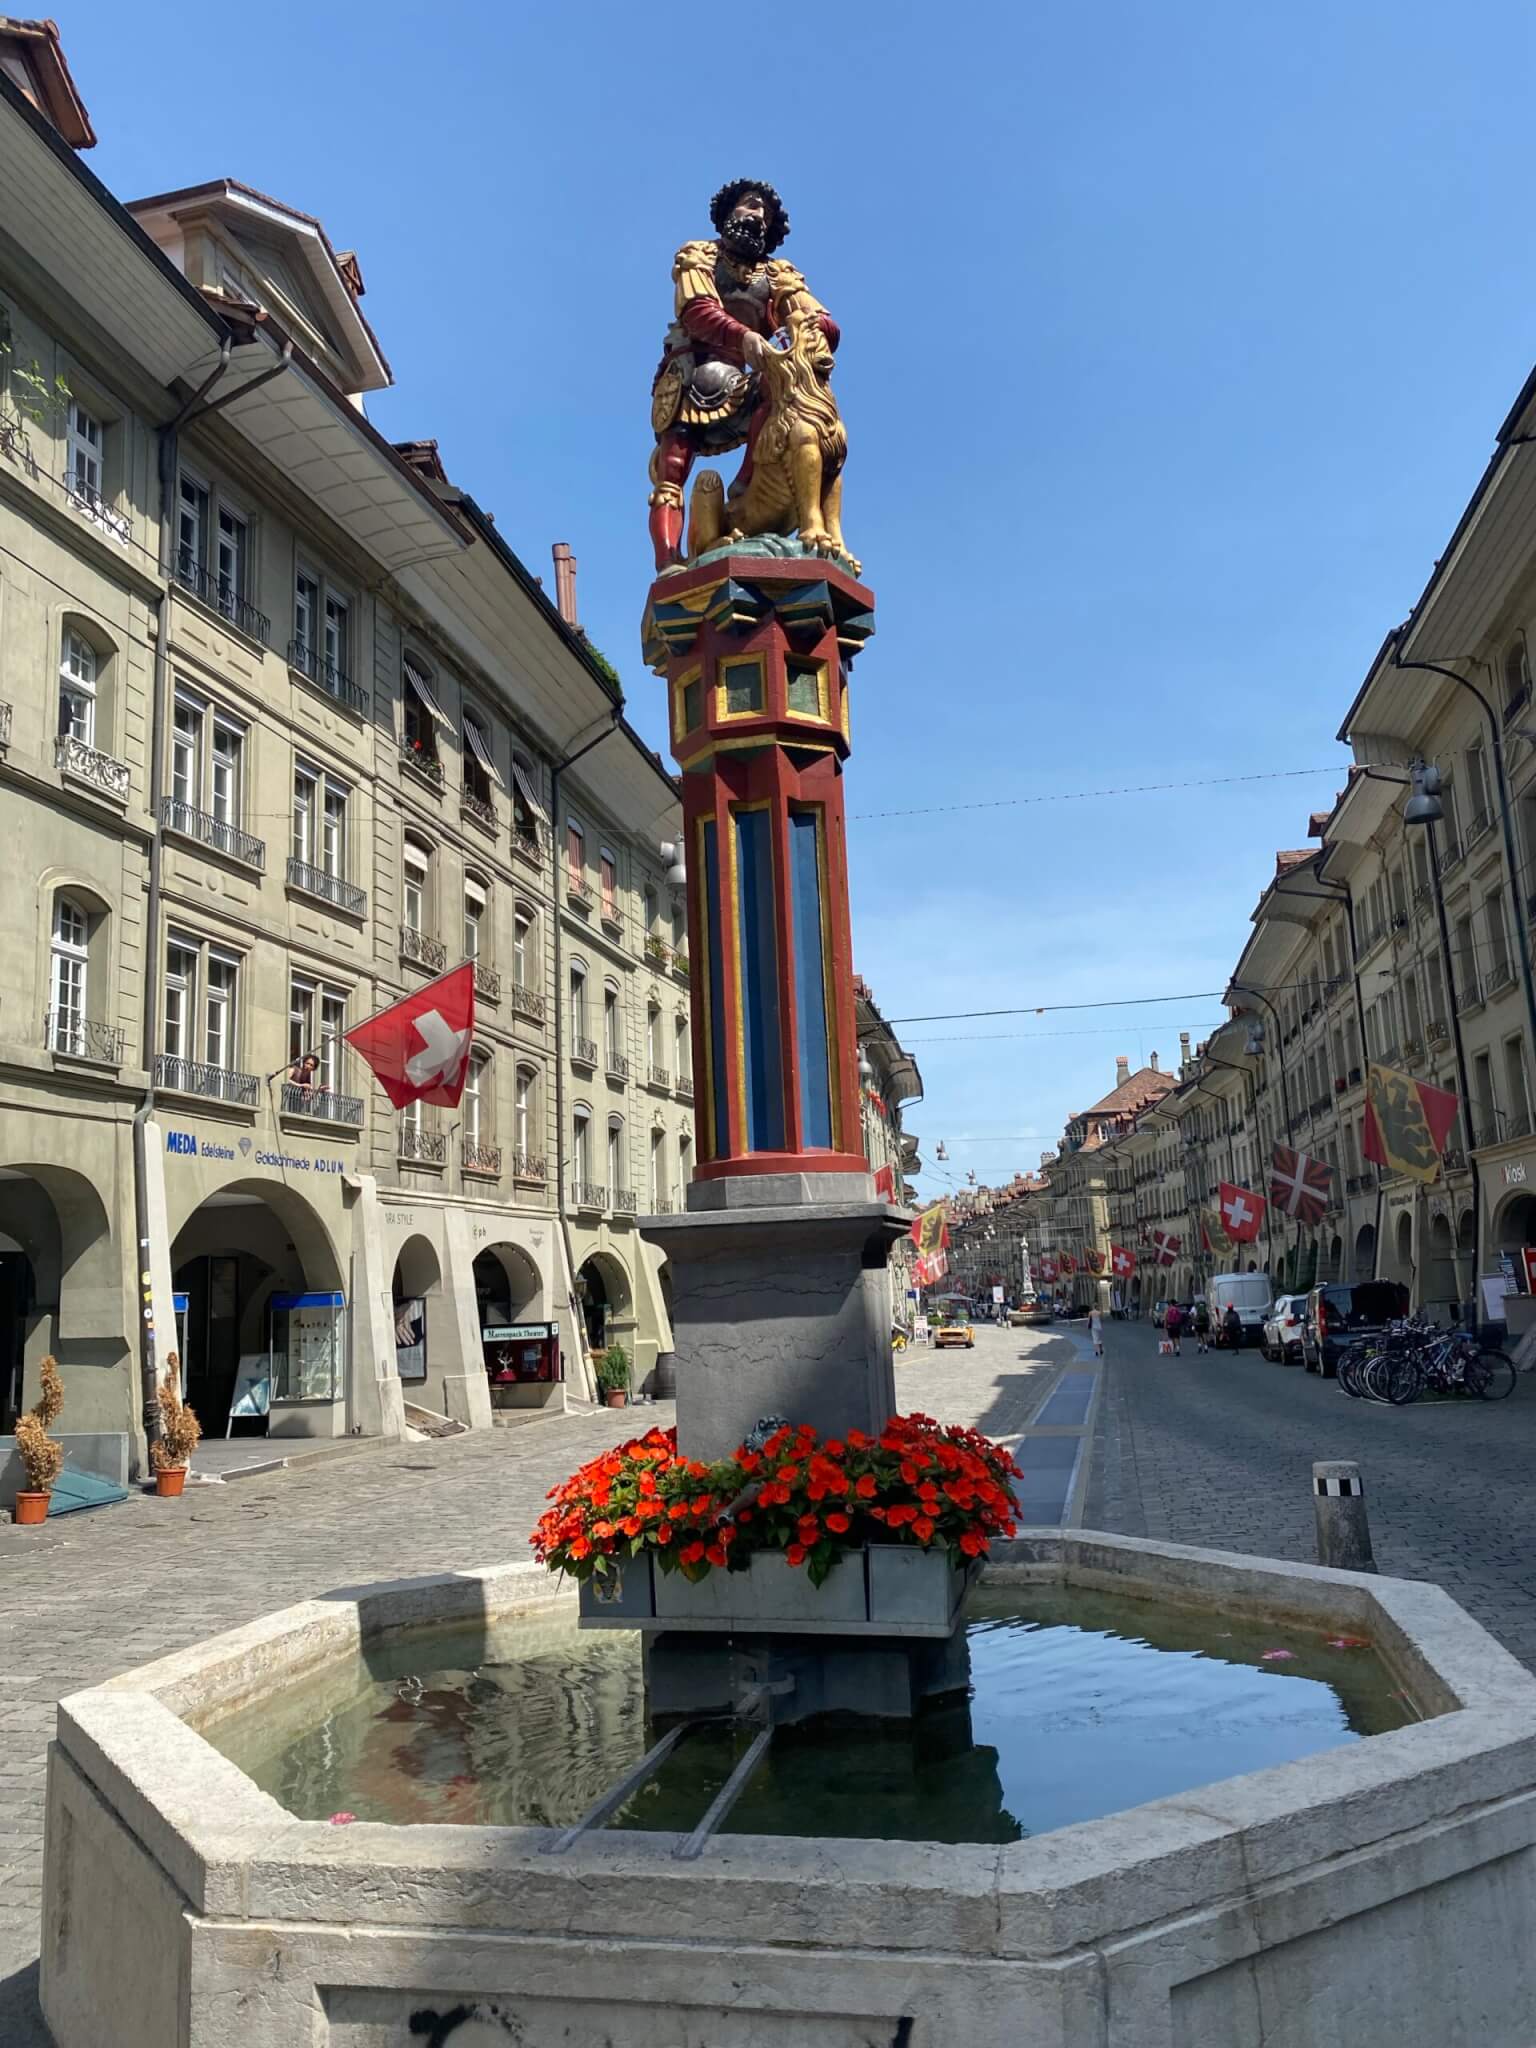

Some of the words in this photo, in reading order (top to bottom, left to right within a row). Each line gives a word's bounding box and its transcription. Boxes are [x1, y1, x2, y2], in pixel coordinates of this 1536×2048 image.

[166, 1131, 198, 1155] MEDA
[201, 1142, 235, 1161] Edelsteine
[255, 1150, 310, 1171] Goldschmiede
[313, 1159, 344, 1173] ADLUN
[1504, 1162, 1527, 1184] kiosk
